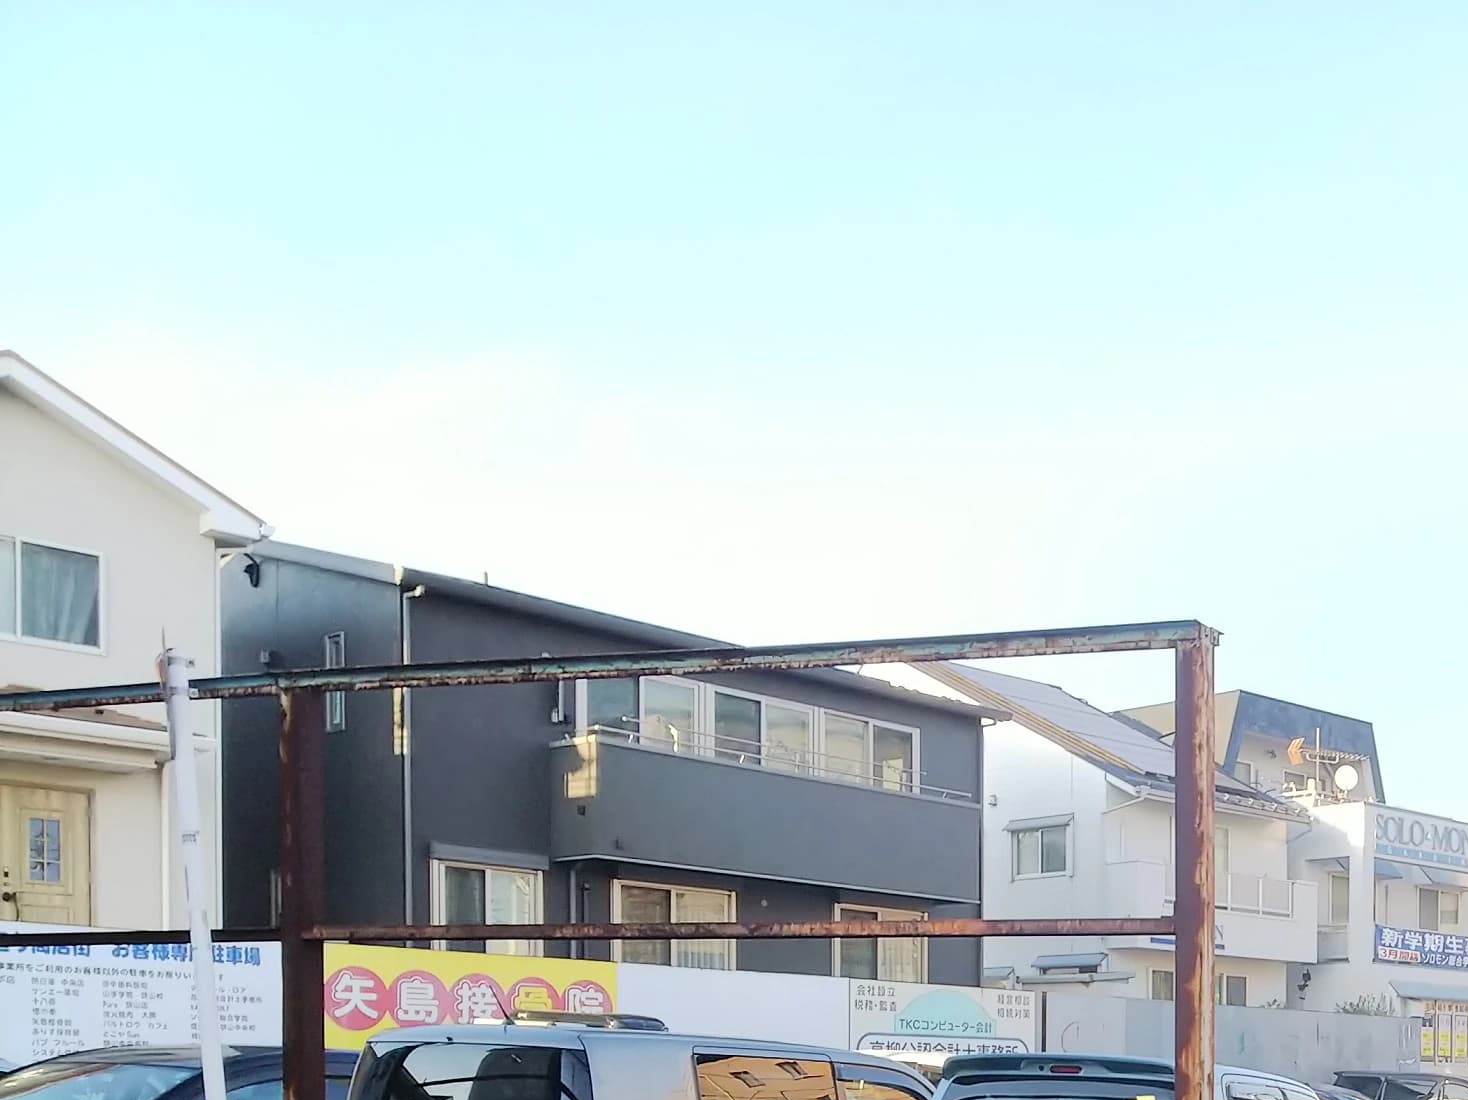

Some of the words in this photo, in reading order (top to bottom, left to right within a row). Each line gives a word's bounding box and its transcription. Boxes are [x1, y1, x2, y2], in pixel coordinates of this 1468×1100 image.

[899, 1017, 993, 1035] TKCコンピューター会計
